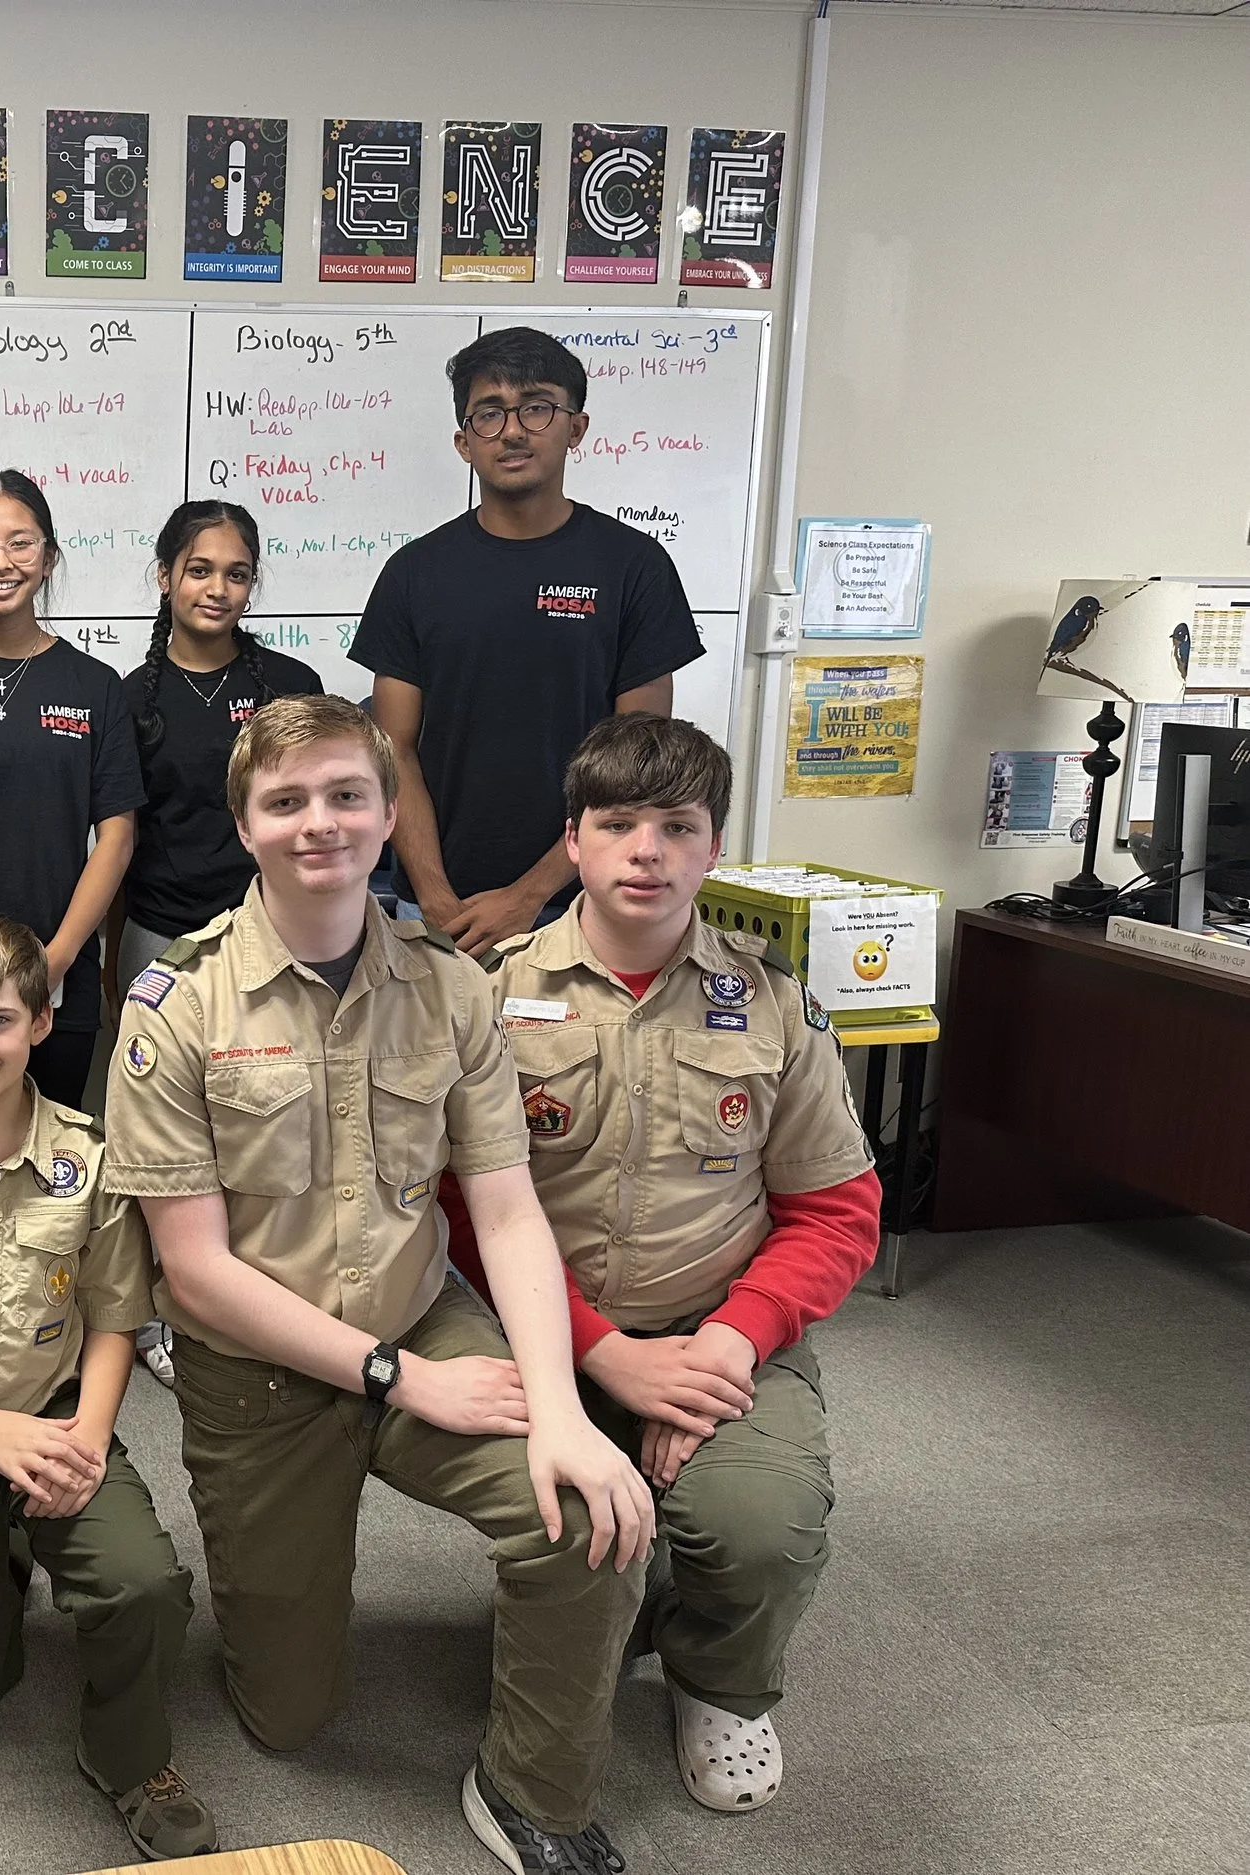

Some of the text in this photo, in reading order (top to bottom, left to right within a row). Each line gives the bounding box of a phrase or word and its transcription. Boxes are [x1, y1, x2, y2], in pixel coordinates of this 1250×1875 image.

[63, 260, 132, 271] COME TO CLASS
[187, 262, 278, 274] INTEGRITY IS IMPORTANT
[324, 264, 410, 276] ENGAGE YOUR MIND
[452, 264, 526, 274] NO DISTRACTIONS
[569, 265, 654, 276] CHALLENGE YOURSELF
[686, 269, 714, 279] EMBRACE
[714, 270, 731, 280] YOUR
[90, 320, 137, 355] 2nd
[355, 323, 398, 352] 5th
[703, 326, 738, 353] 3rd
[587, 357, 616, 378] Lab
[640, 357, 706, 378] 148-149
[3, 388, 31, 416] Lab
[206, 391, 252, 418] HW:
[258, 388, 296, 417] Read
[326, 390, 393, 410] 106-107
[250, 419, 293, 436] Lab
[593, 437, 631, 464] Chp.
[632, 431, 649, 452] 5
[56, 463, 70, 483] 4
[79, 462, 134, 485] vocab.
[210, 459, 237, 489] Q:
[370, 450, 385, 470] 4
[104, 528, 114, 549] 4
[302, 538, 328, 552] Nov.
[380, 531, 392, 548] 4
[868, 542, 914, 550] Expectations
[538, 584, 598, 600] LAMBERT
[850, 580, 886, 588] Respectful
[537, 596, 596, 614] HOSA
[548, 612, 586, 620] 2024-2025
[77, 625, 120, 653] 4th
[827, 670, 884, 680] When you pass
[808, 684, 896, 700] through the waters
[40, 705, 91, 721] LAMBERT
[804, 700, 826, 742] I
[826, 706, 883, 722] WILL BE
[40, 716, 90, 734] HOSA
[825, 724, 868, 738] WITH
[52, 729, 82, 740] 2024-2025
[814, 752, 838, 760] through
[842, 744, 860, 760] the
[1114, 922, 1136, 942] Faith
[1148, 936, 1158, 946] MY
[1160, 940, 1180, 950] HEART
[1184, 942, 1207, 960] coffee
[1210, 952, 1216, 960] IN
[1220, 954, 1230, 964] MY
[1231, 957, 1246, 967] CUP
[211, 1051, 226, 1060] BOY
[228, 1048, 254, 1059] SCOUTS
[264, 1046, 294, 1056] AMERICA
